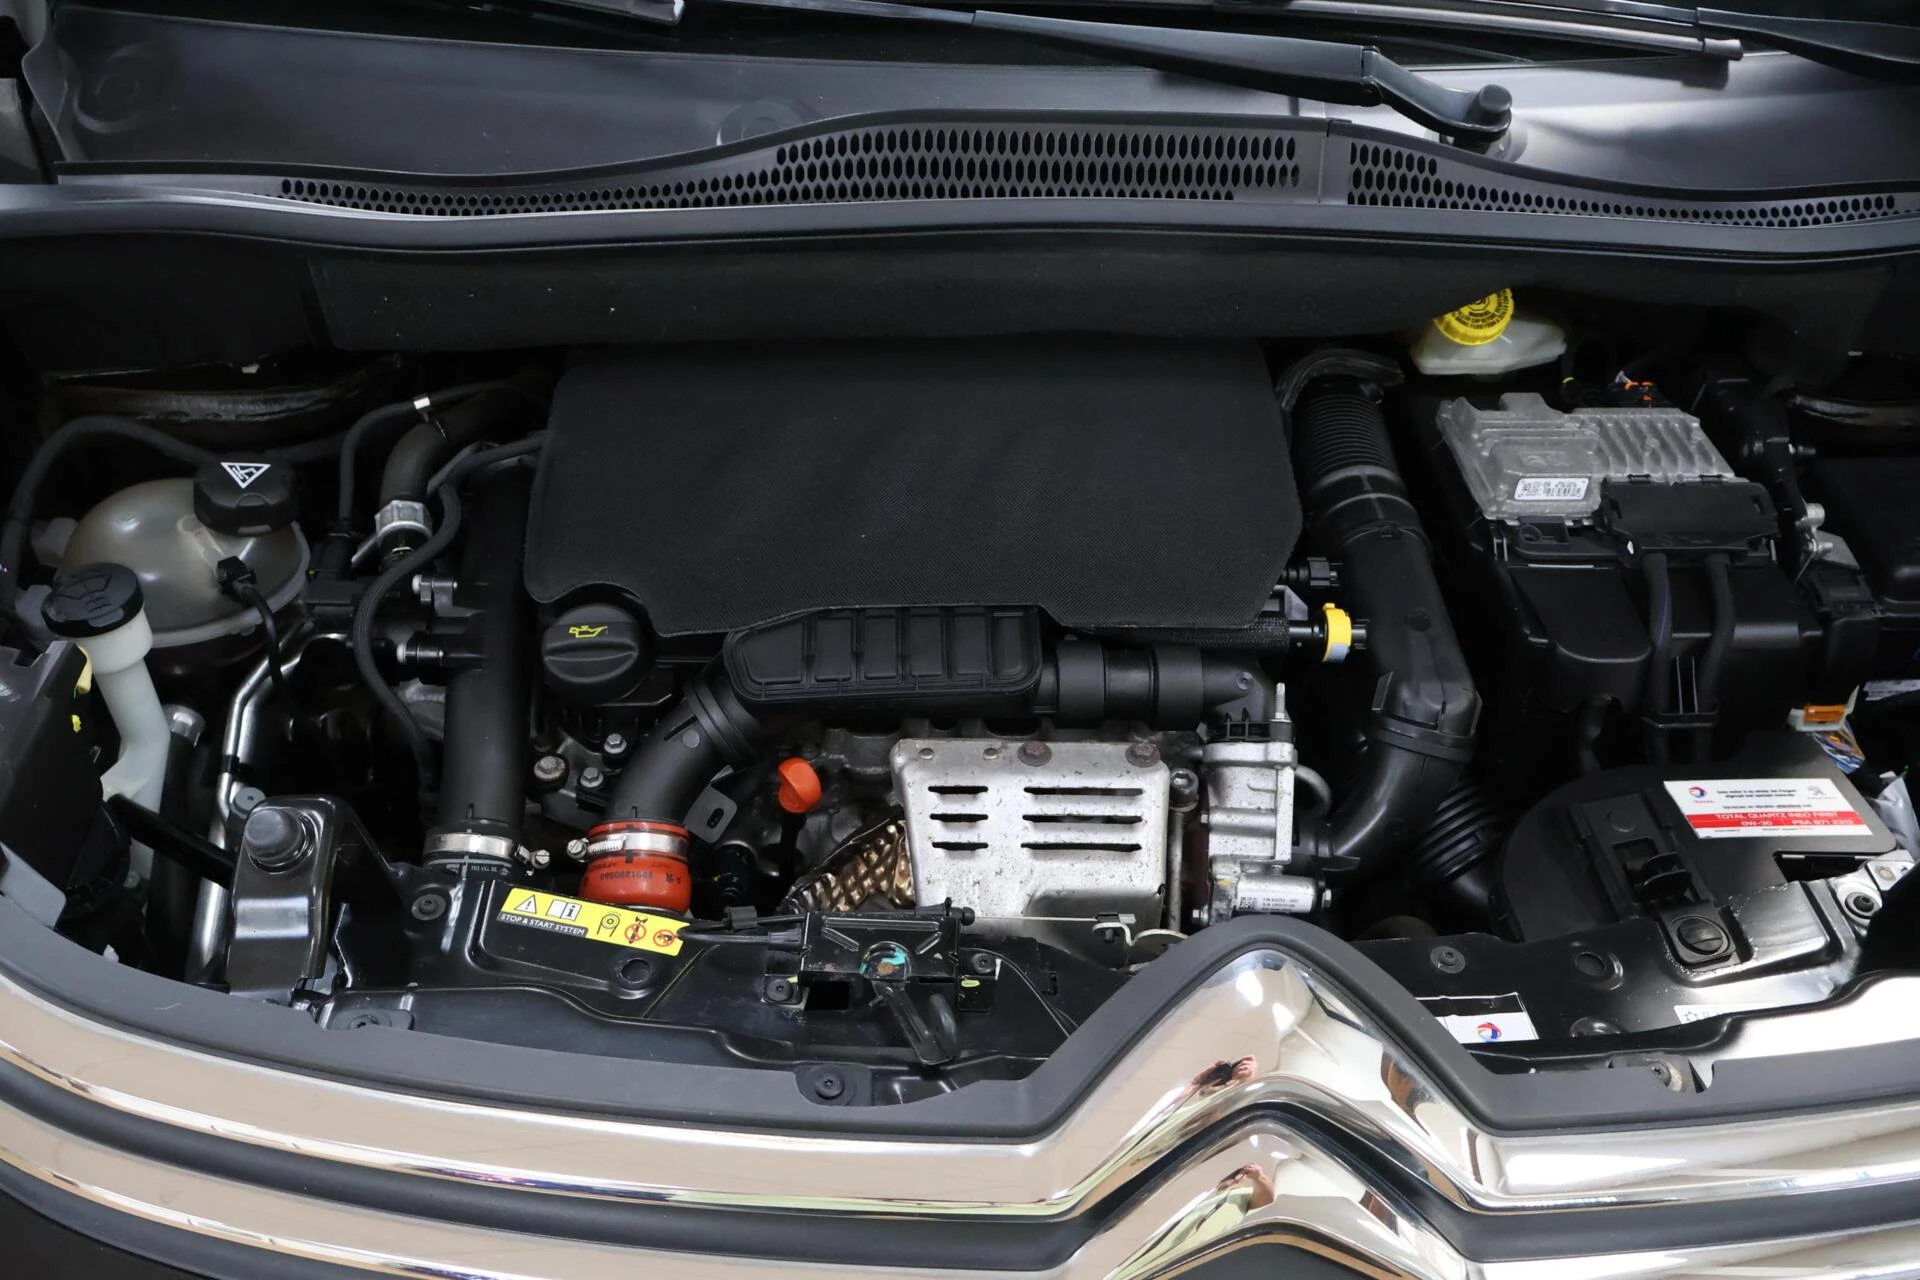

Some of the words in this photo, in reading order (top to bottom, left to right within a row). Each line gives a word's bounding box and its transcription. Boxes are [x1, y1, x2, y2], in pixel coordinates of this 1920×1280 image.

[500, 913, 523, 923] STOP
[529, 918, 555, 930] START
[553, 923, 586, 936] SYSTEM
